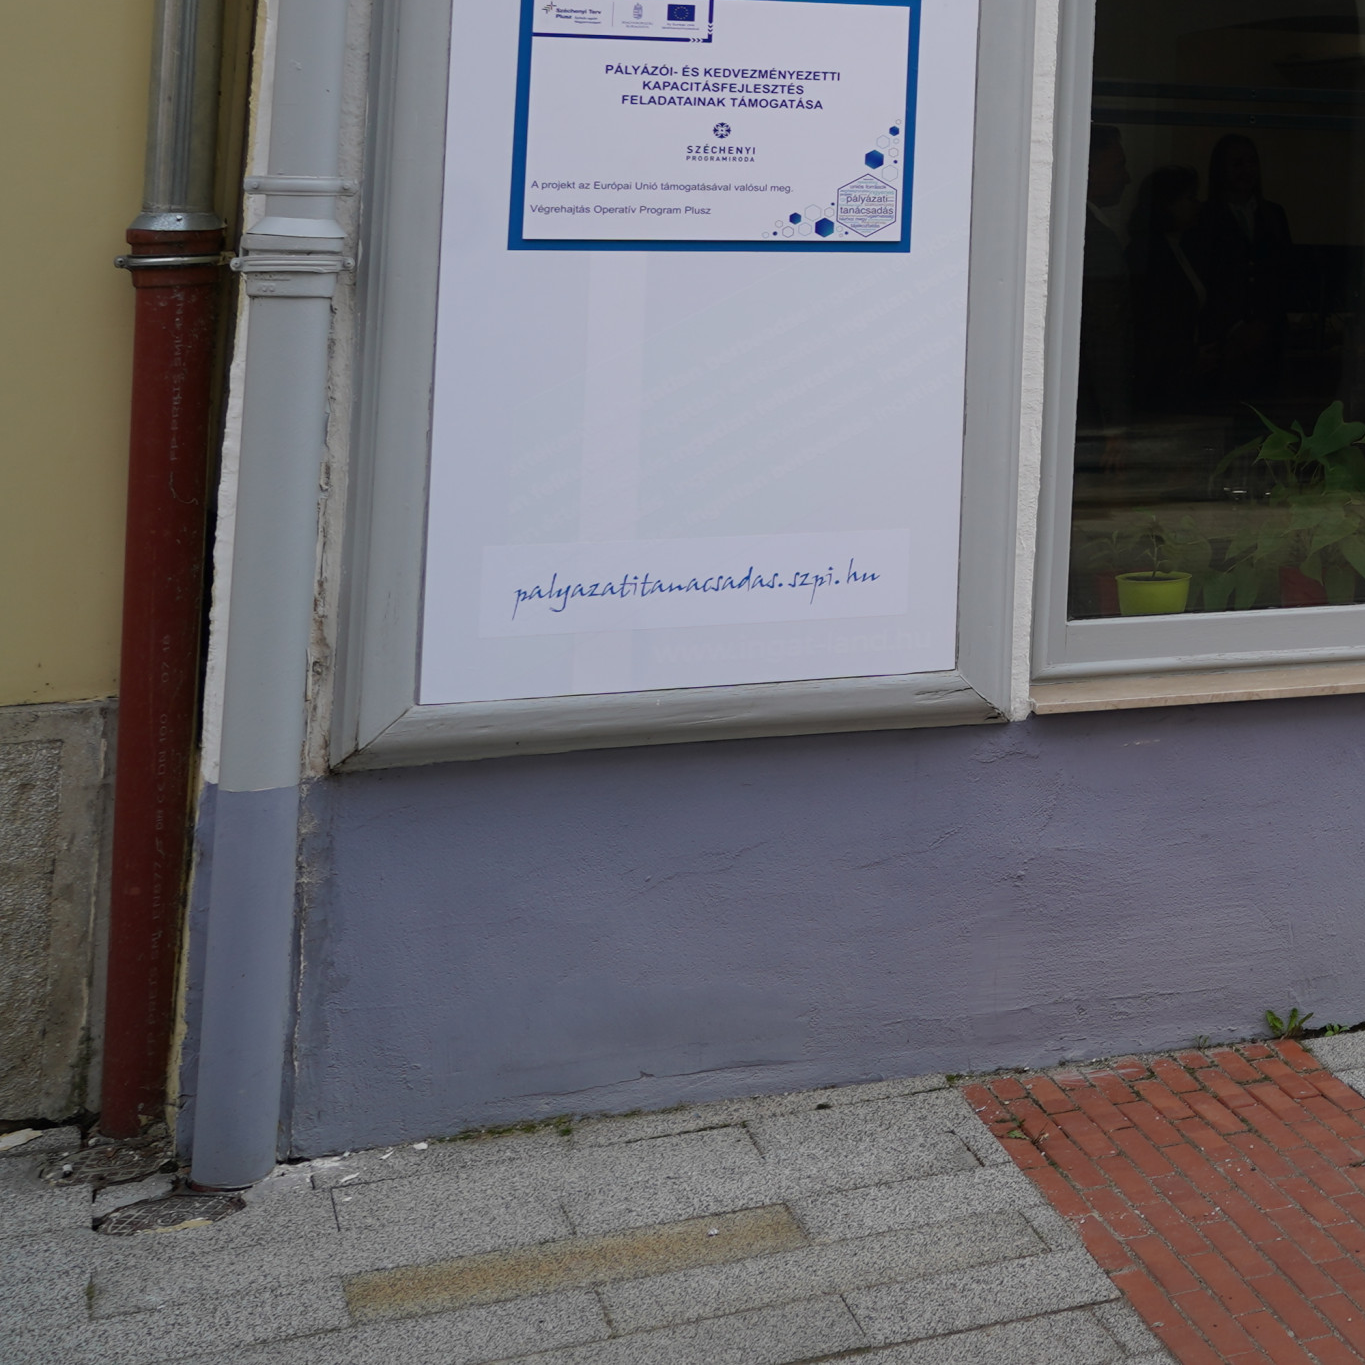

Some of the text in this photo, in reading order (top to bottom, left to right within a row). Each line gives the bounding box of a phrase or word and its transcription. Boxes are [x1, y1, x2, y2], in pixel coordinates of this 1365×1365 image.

[605, 63, 840, 81] PÁLYÁZÓI- ÉS KEDVEZMÉNYEZETTI
[642, 80, 804, 95] KAPACITÁSFEJLESZTÉS
[622, 95, 823, 110] FELADATAINAK TÁMOGATÁSA
[686, 143, 756, 155] SZÉCHENYI
[686, 155, 755, 163] PROGRAMIRODA
[531, 181, 539, 190] A
[542, 181, 575, 193] projekt
[594, 181, 631, 194] Európai
[635, 182, 658, 191] Unió
[660, 183, 731, 195] támogatásával
[734, 183, 767, 192] valósul
[771, 186, 794, 195] meg.
[847, 195, 888, 204] pályázati
[531, 205, 711, 218] Végrehajtás Operatív Program Plusz
[840, 206, 893, 214] tanácsadás
[511, 558, 881, 621] palyazatitanacsadas.szpi.hu
